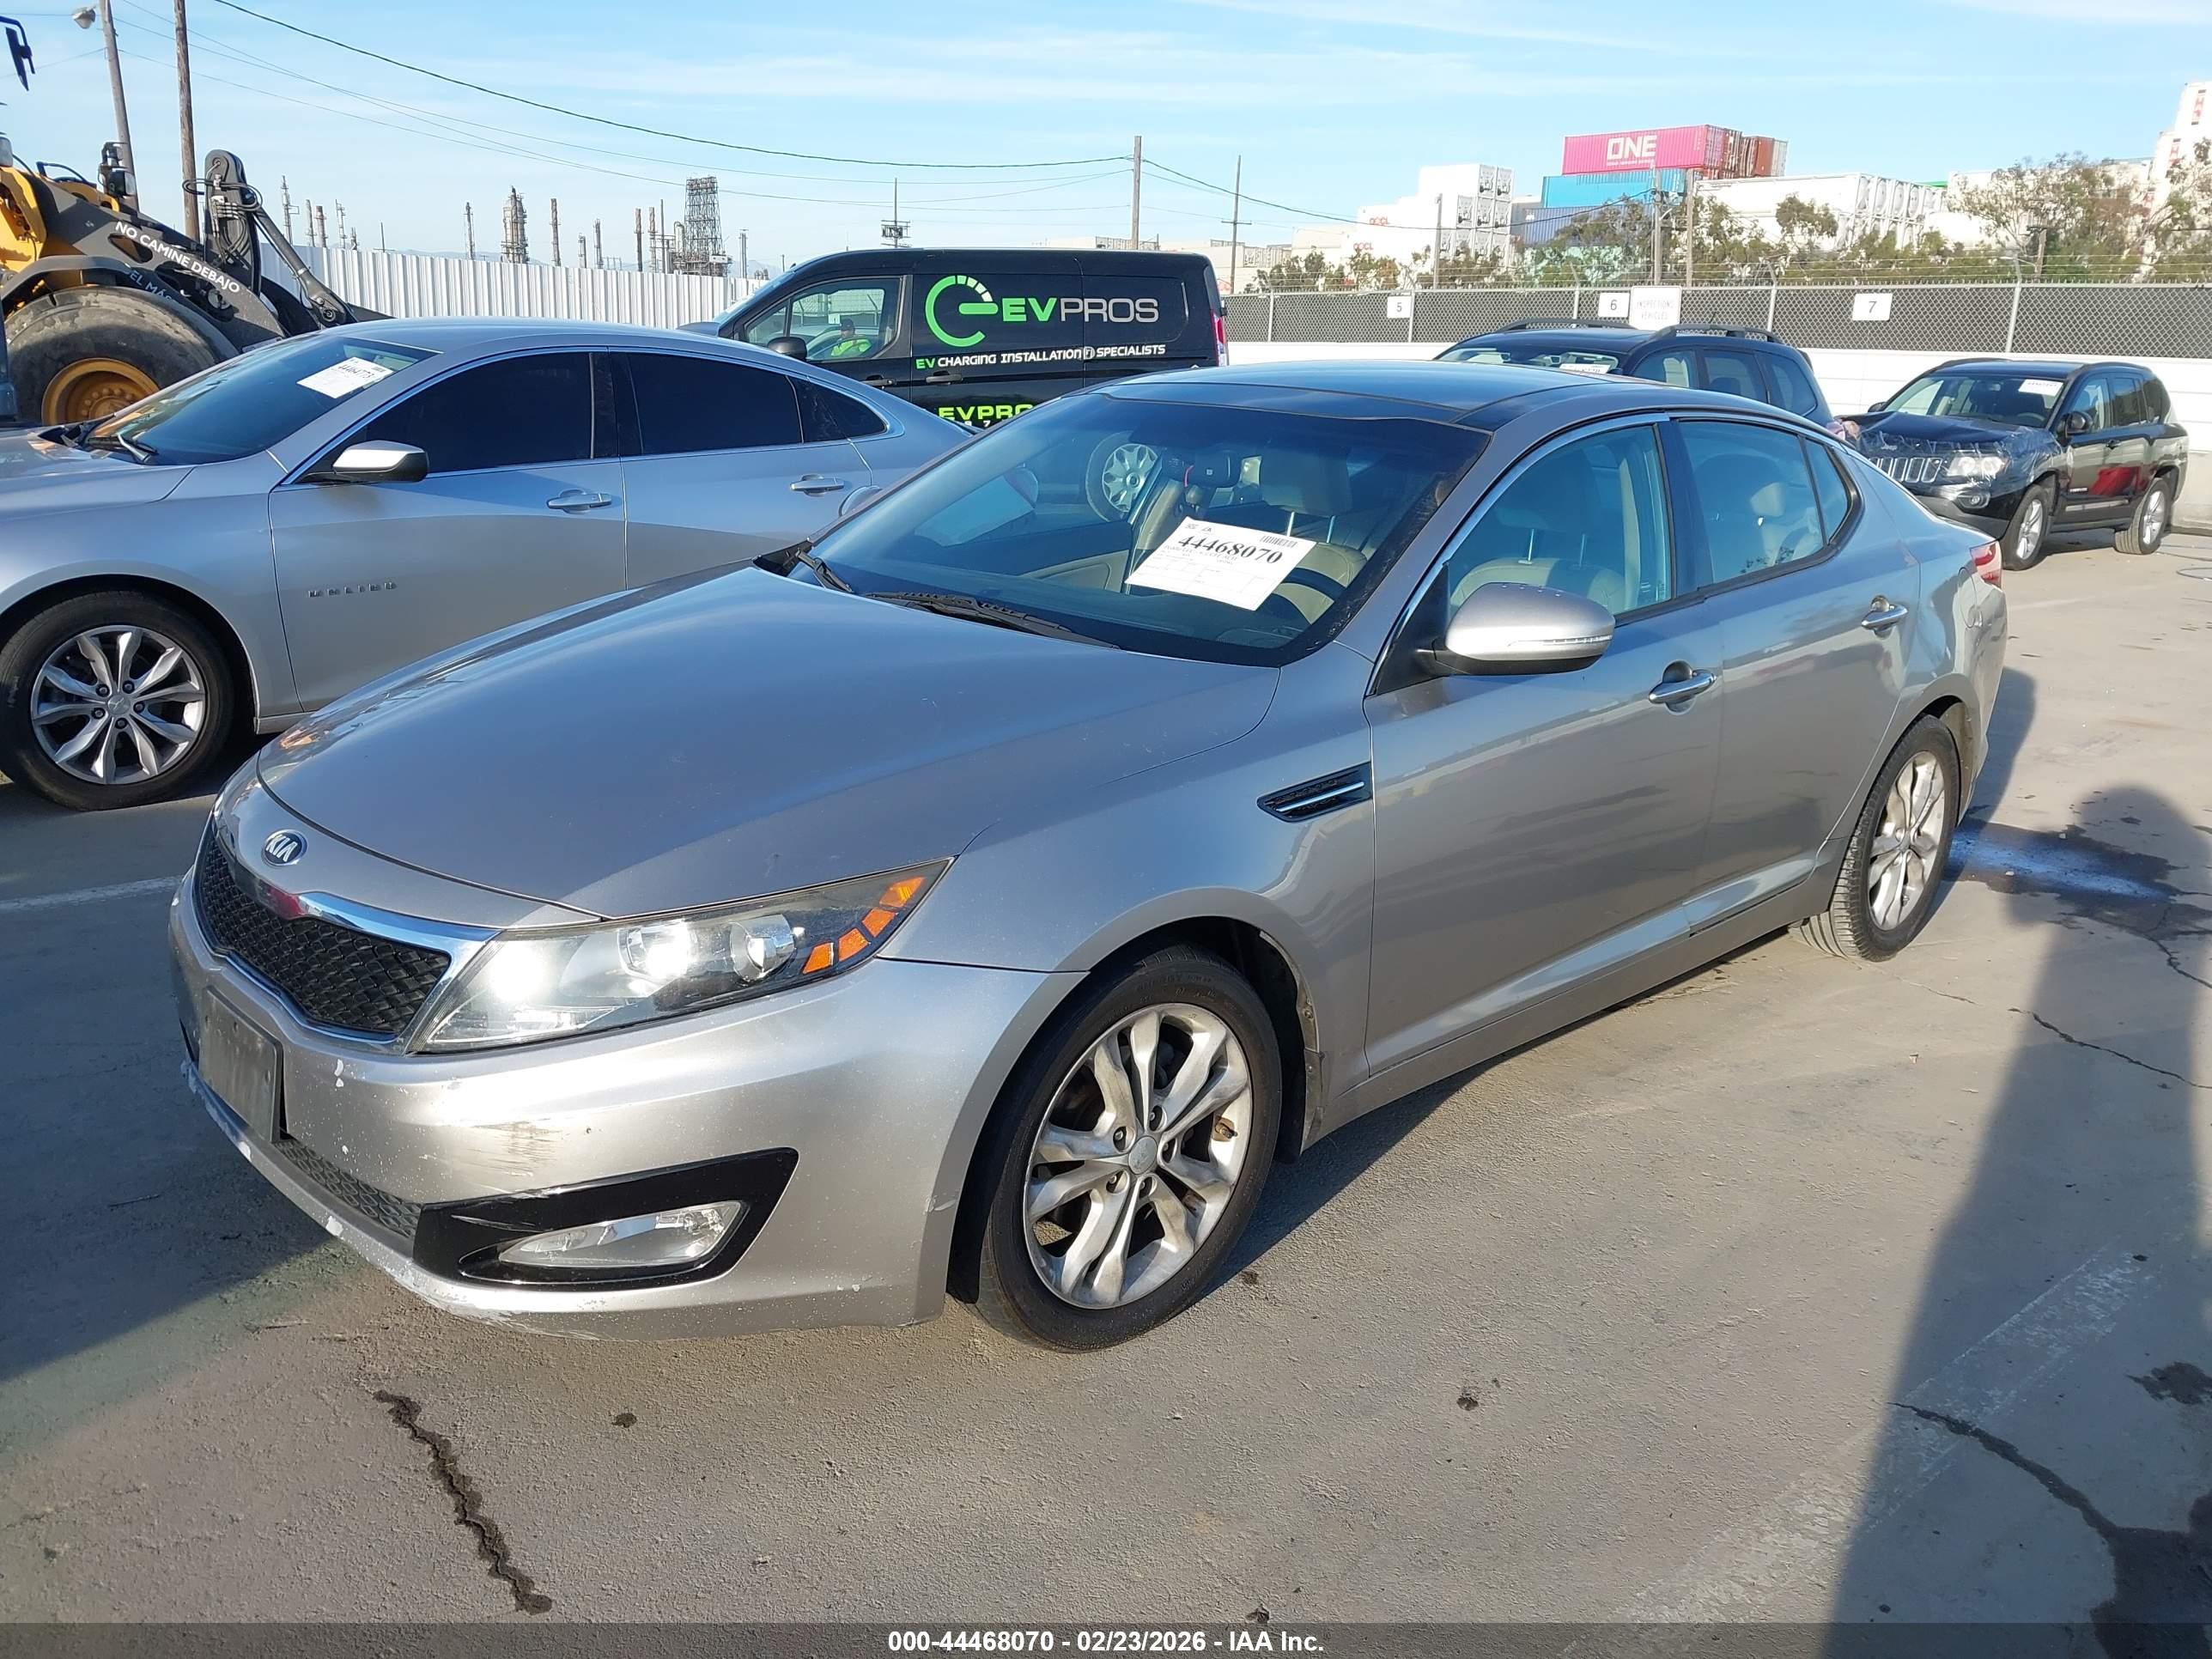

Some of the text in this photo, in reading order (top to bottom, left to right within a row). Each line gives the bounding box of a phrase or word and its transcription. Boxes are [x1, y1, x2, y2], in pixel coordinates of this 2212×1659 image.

[1607, 135, 1657, 160] ONE
[115, 221, 240, 293] NO CAMINE DEBAJO
[1001, 297, 1159, 323] EVPROS
[1396, 301, 1402, 313] 5
[1610, 299, 1617, 311] 6
[1869, 301, 1877, 313] 7
[915, 344, 1166, 369] EV CHARGING INSTALLATION SPECIALISTS
[1178, 535, 1283, 564] 44468070
